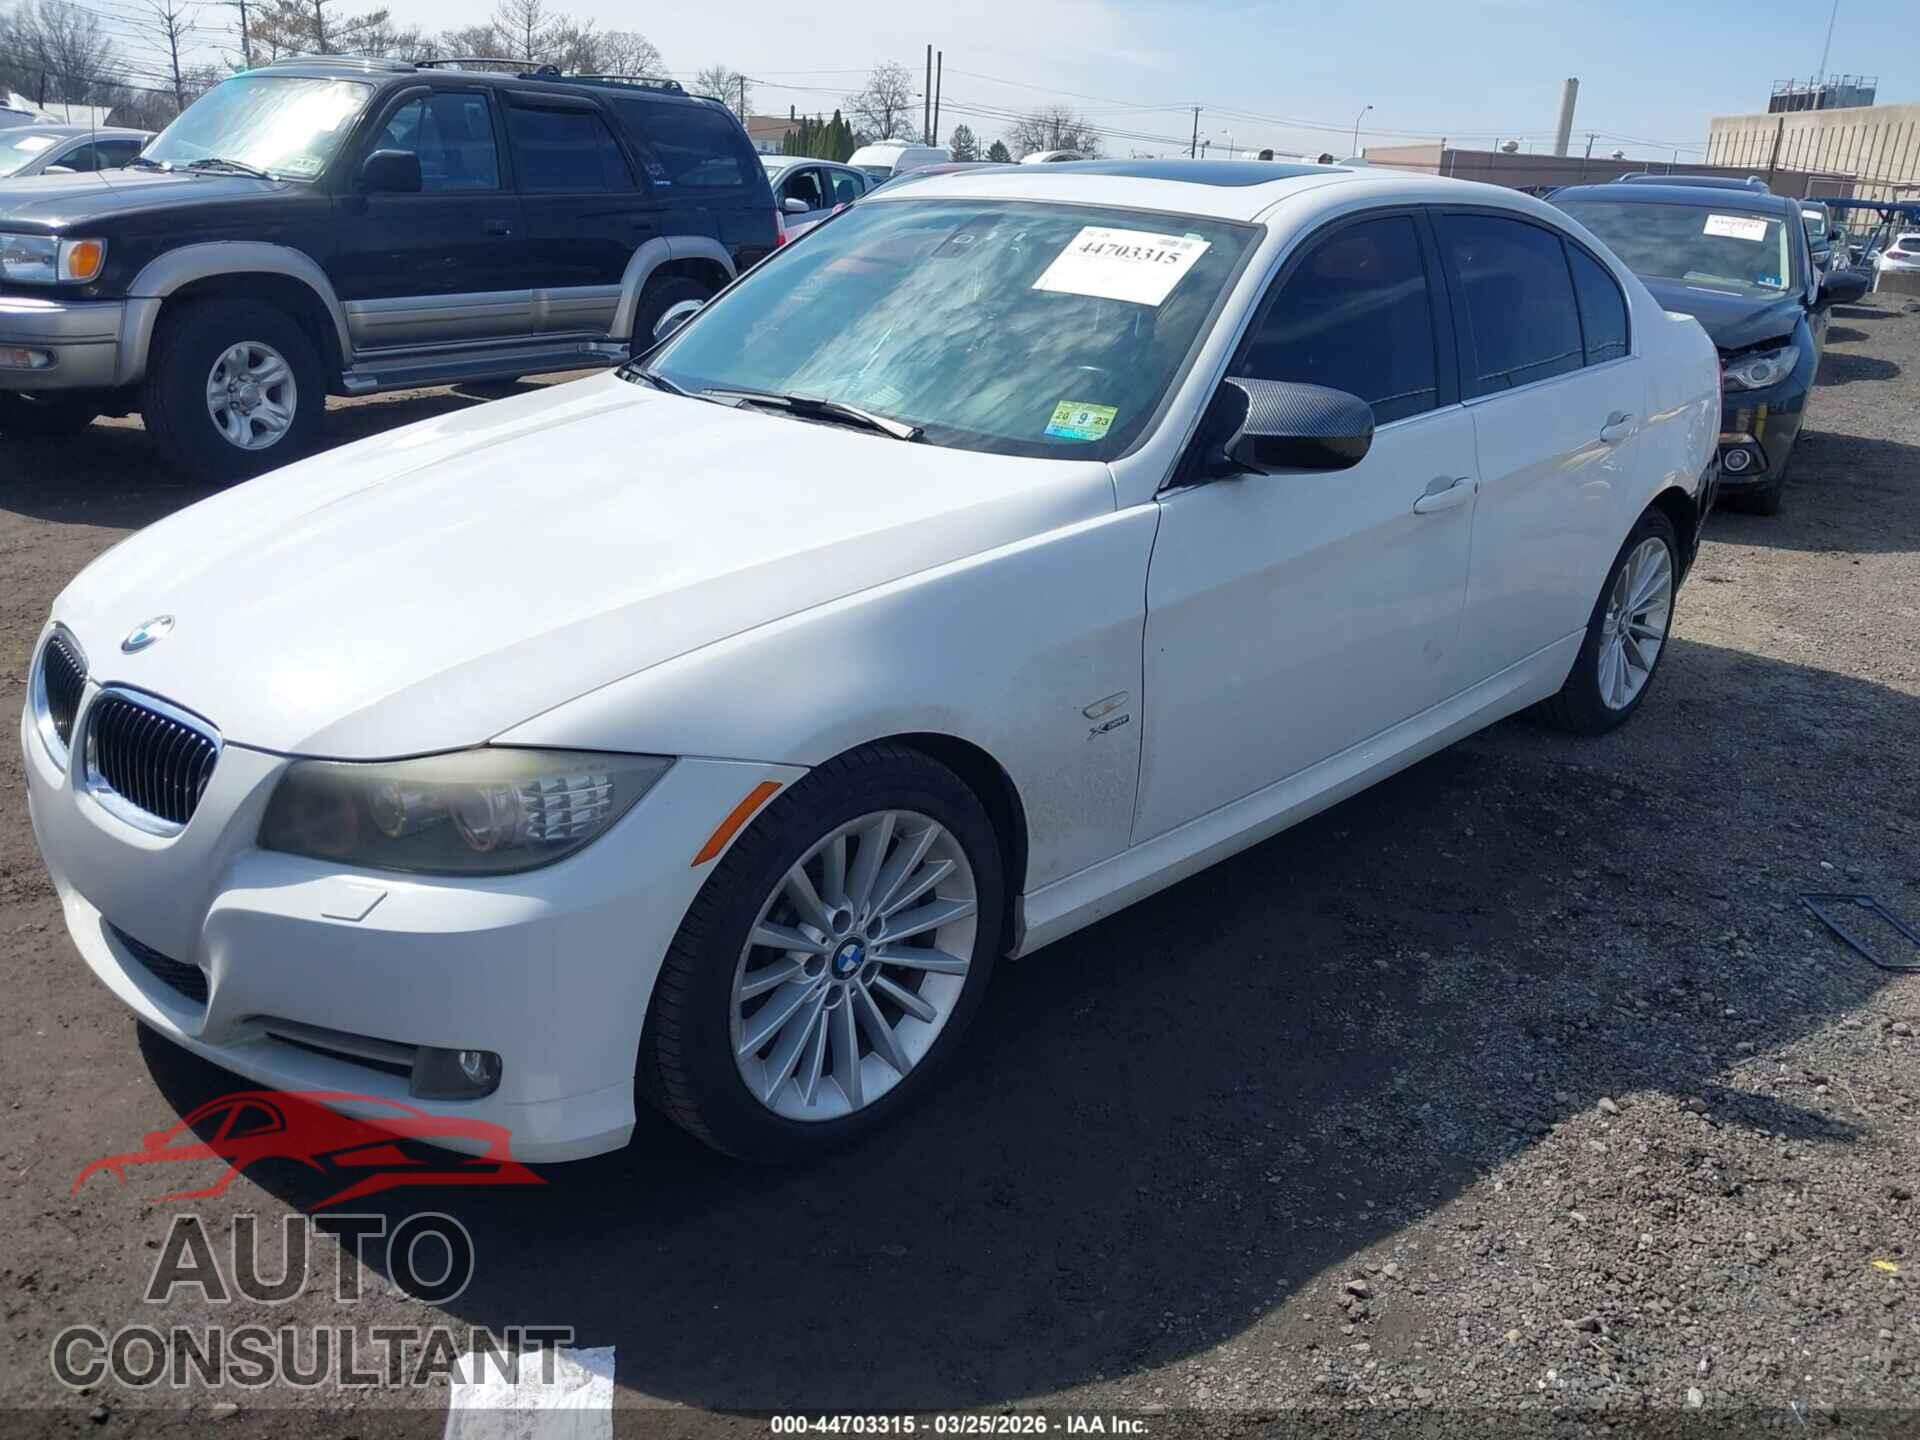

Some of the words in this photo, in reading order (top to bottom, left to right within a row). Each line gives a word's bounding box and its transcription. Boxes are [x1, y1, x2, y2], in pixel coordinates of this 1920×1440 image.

[1078, 241, 1182, 265] 44703315
[1078, 412, 1089, 425] 9
[1095, 416, 1109, 426] 23
